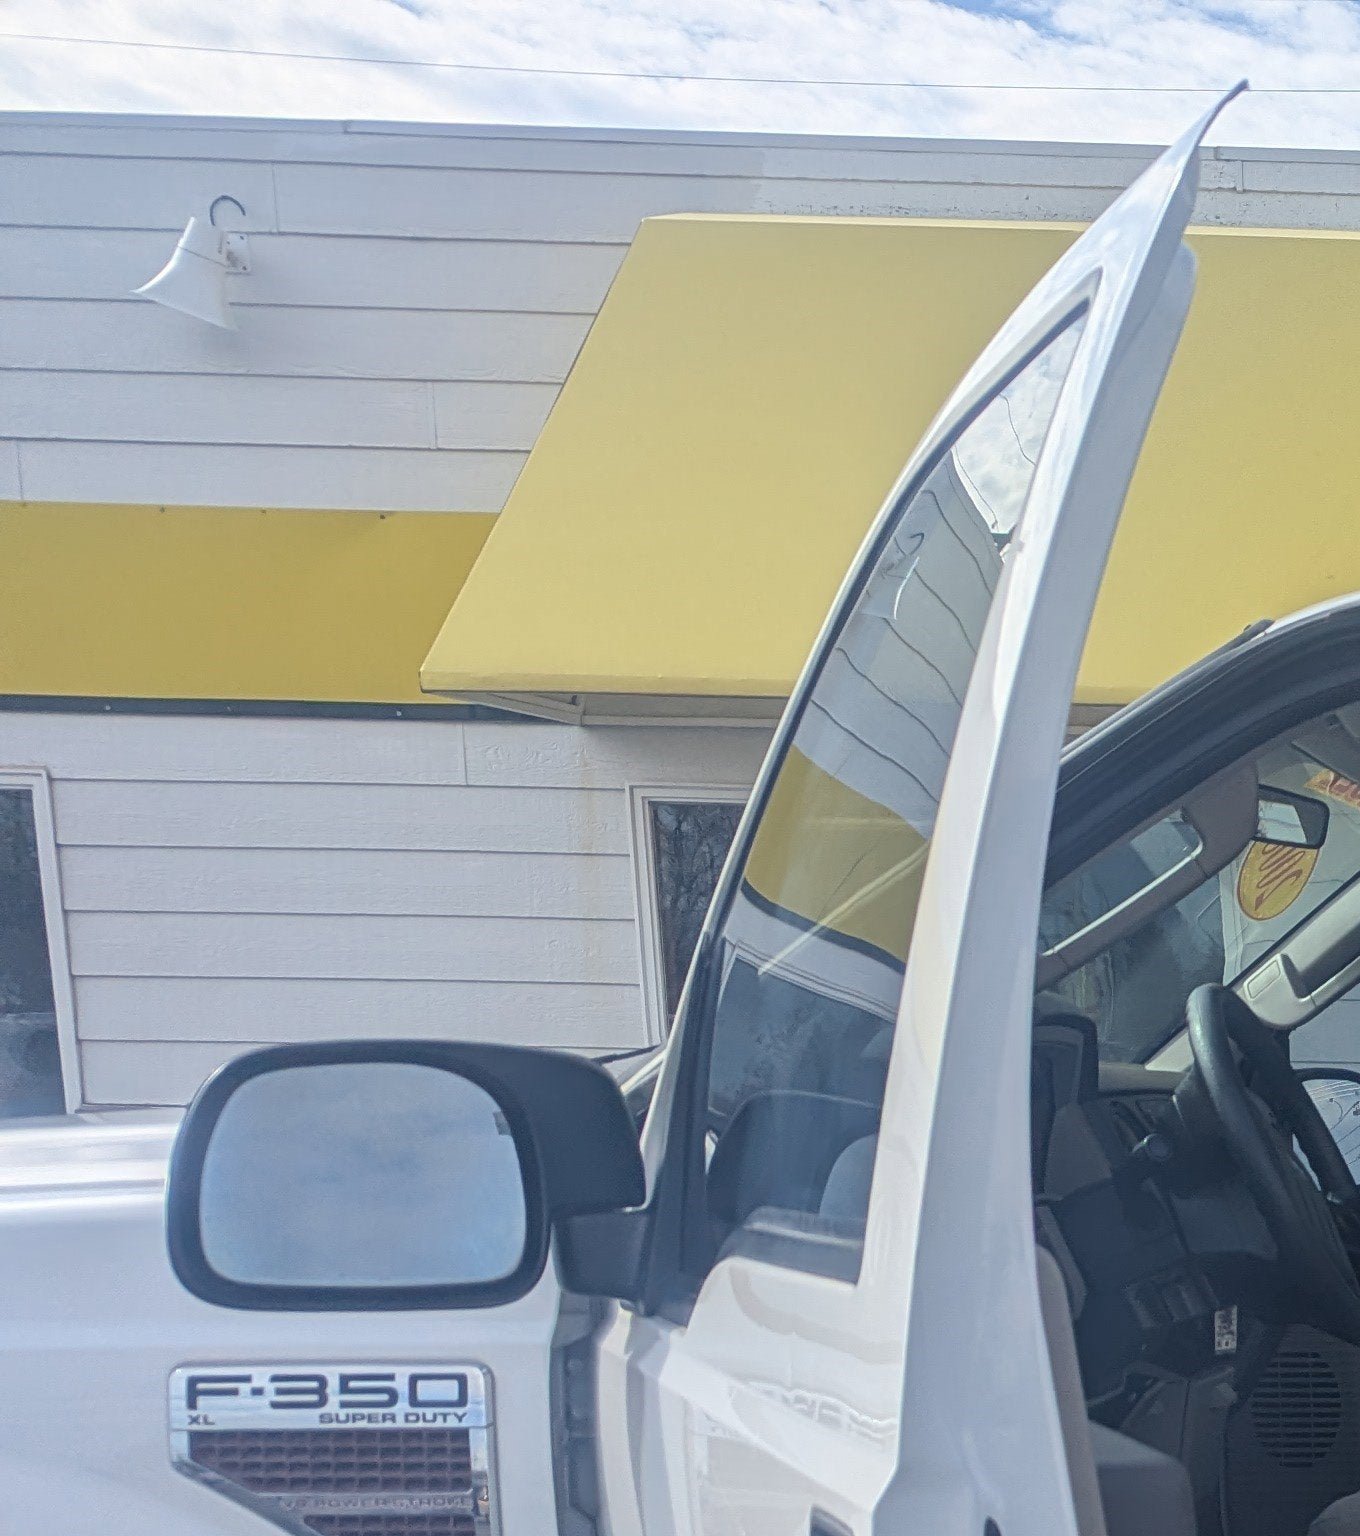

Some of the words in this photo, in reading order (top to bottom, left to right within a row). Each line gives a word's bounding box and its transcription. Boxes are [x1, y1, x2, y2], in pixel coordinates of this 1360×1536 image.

[186, 1373, 469, 1410] F-350
[187, 1414, 215, 1426] XL
[318, 1412, 397, 1424] SUPER
[404, 1411, 468, 1424] DUTY
